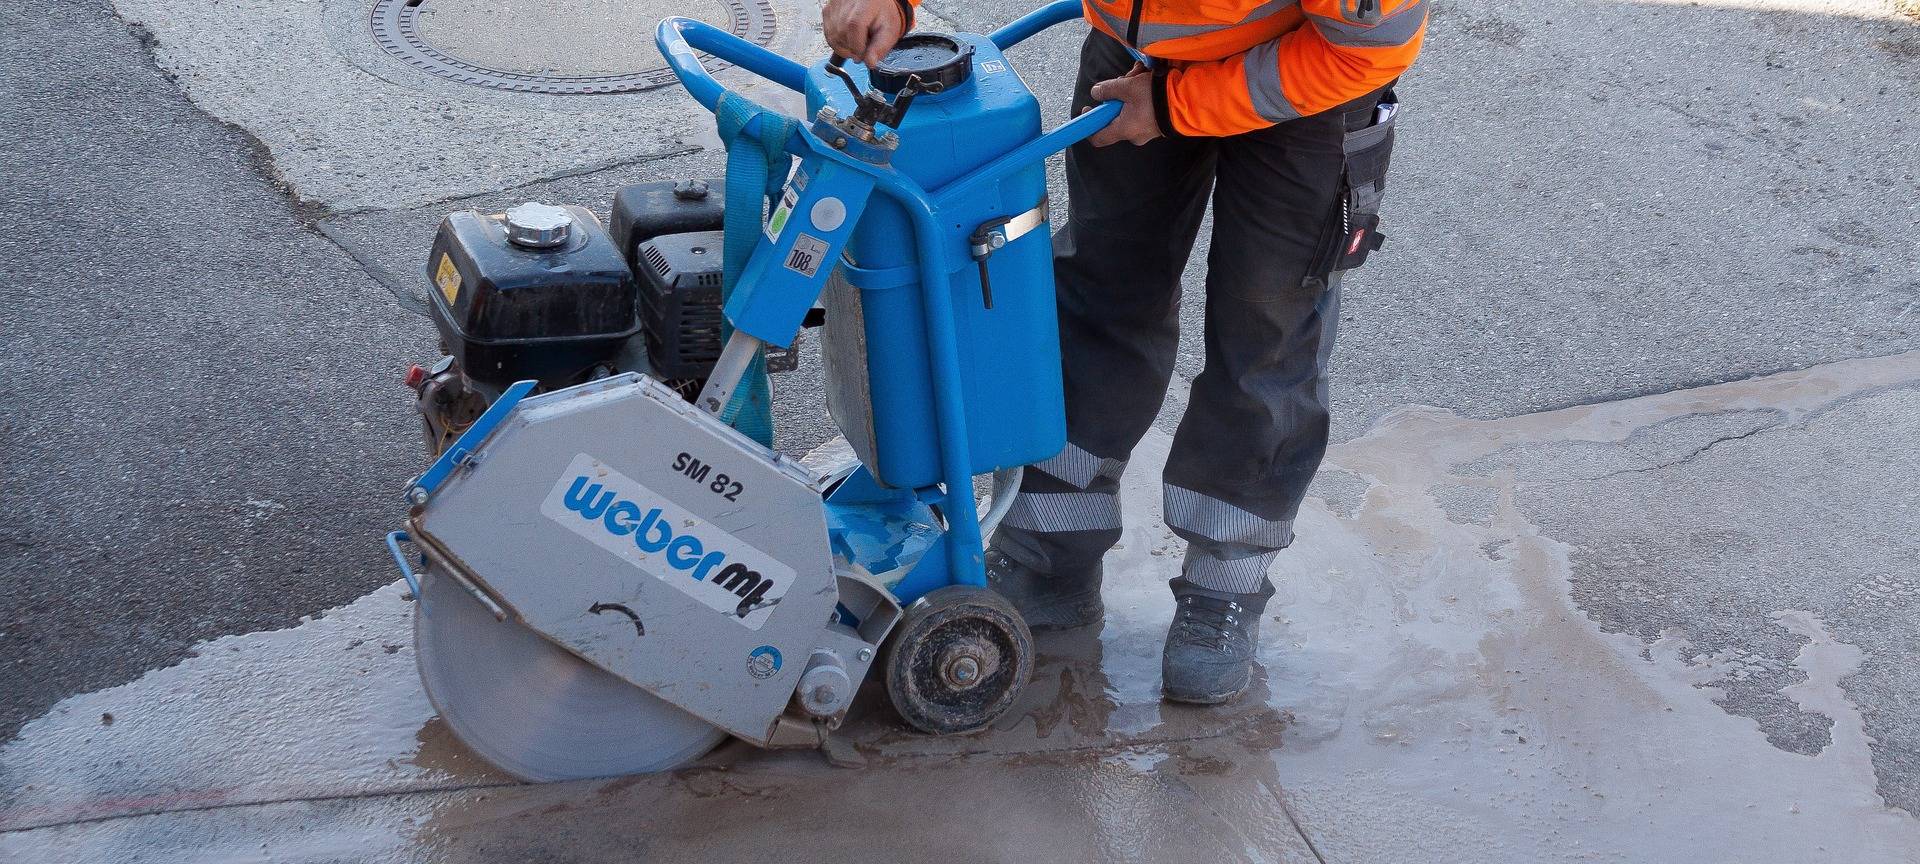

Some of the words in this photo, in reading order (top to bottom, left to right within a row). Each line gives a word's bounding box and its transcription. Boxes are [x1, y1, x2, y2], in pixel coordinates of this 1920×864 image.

[789, 249, 812, 271] 108
[672, 452, 712, 484] SM
[710, 473, 744, 503] 82
[564, 476, 726, 581] weber
